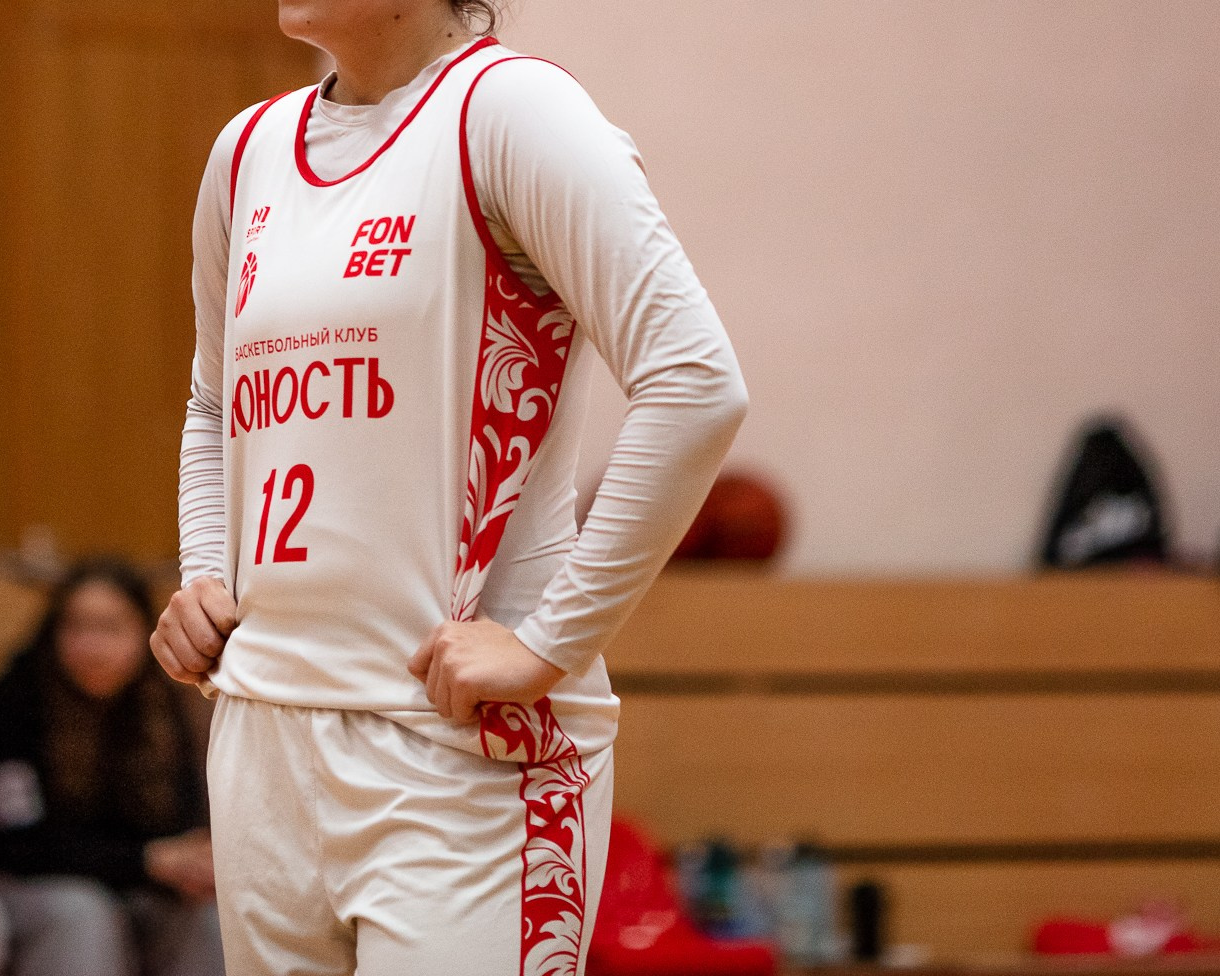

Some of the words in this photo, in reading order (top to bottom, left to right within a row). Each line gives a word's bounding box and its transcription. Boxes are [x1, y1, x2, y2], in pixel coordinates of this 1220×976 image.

[351, 215, 416, 247] FON
[343, 249, 411, 278] BET
[235, 328, 330, 362] БАСКЕТБОЛЬНЫЙ
[335, 327, 379, 343] КЛУБ
[230, 357, 395, 439] ЮНОСТЬ
[254, 463, 315, 565] 12
